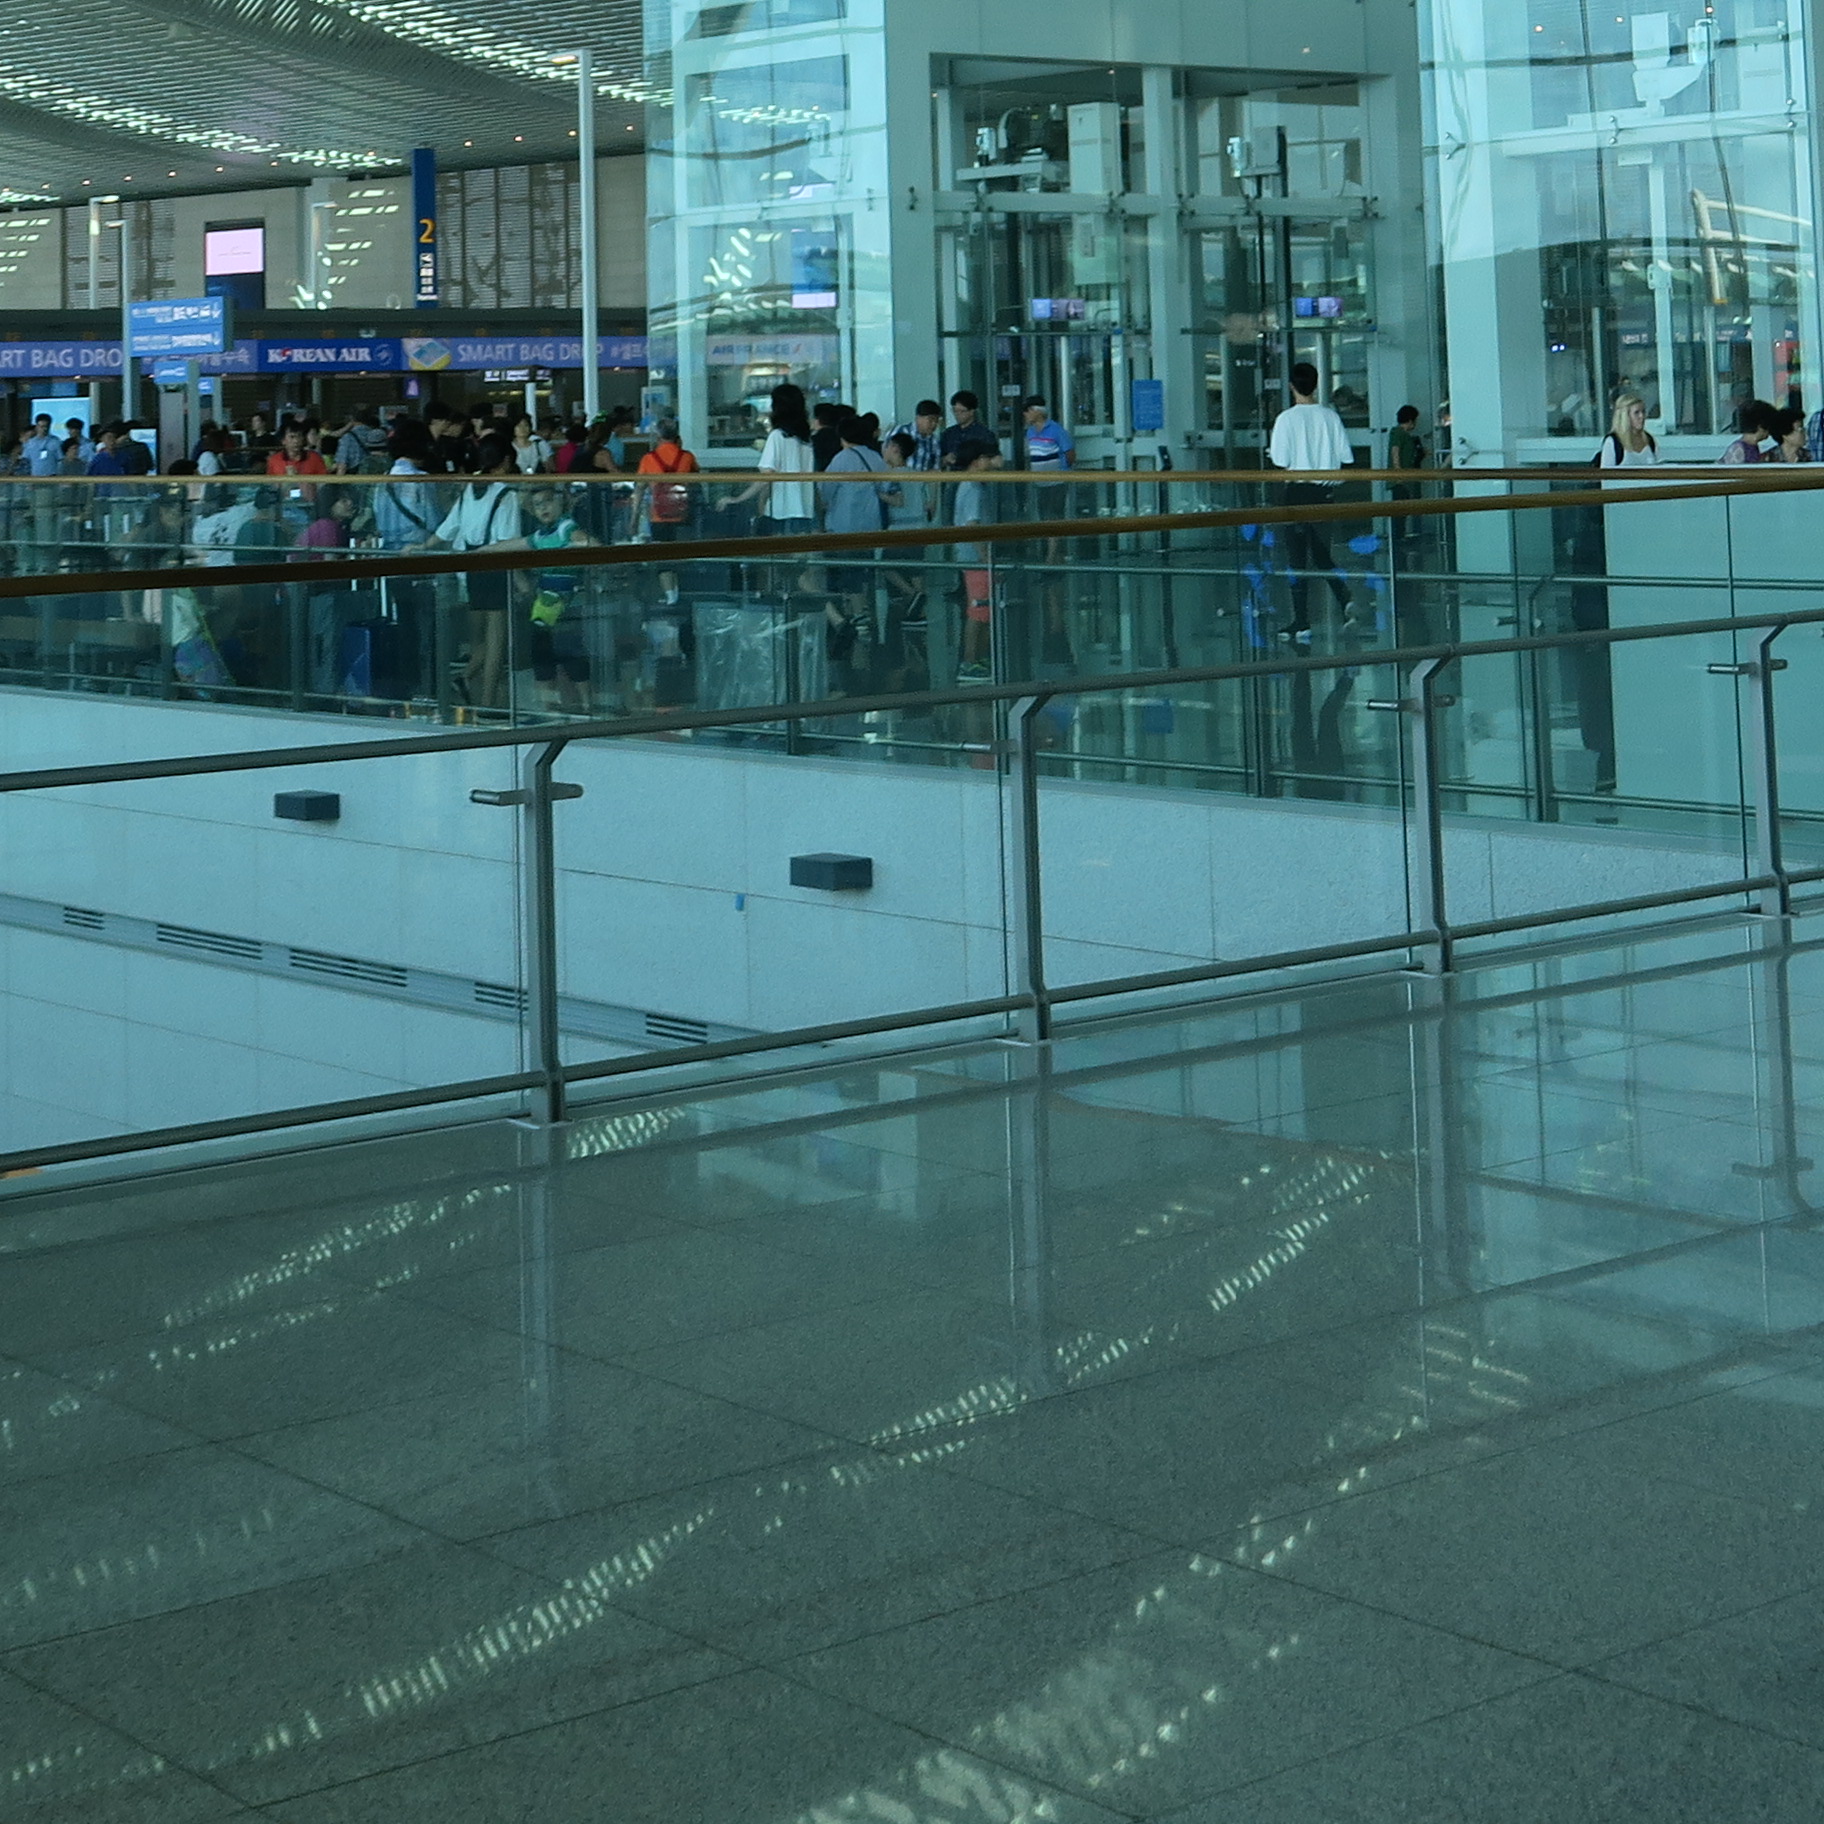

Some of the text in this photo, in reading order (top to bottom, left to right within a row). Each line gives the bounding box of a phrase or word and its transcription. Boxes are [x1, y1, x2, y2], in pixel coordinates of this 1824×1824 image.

[418, 218, 436, 244] 2
[31, 348, 74, 368] BAG
[80, 348, 123, 368] DRO
[267, 348, 335, 364] KOREAN
[336, 347, 372, 362] AIR
[457, 343, 516, 363] SMART
[520, 343, 554, 361] BAG
[559, 342, 604, 360] DRP
